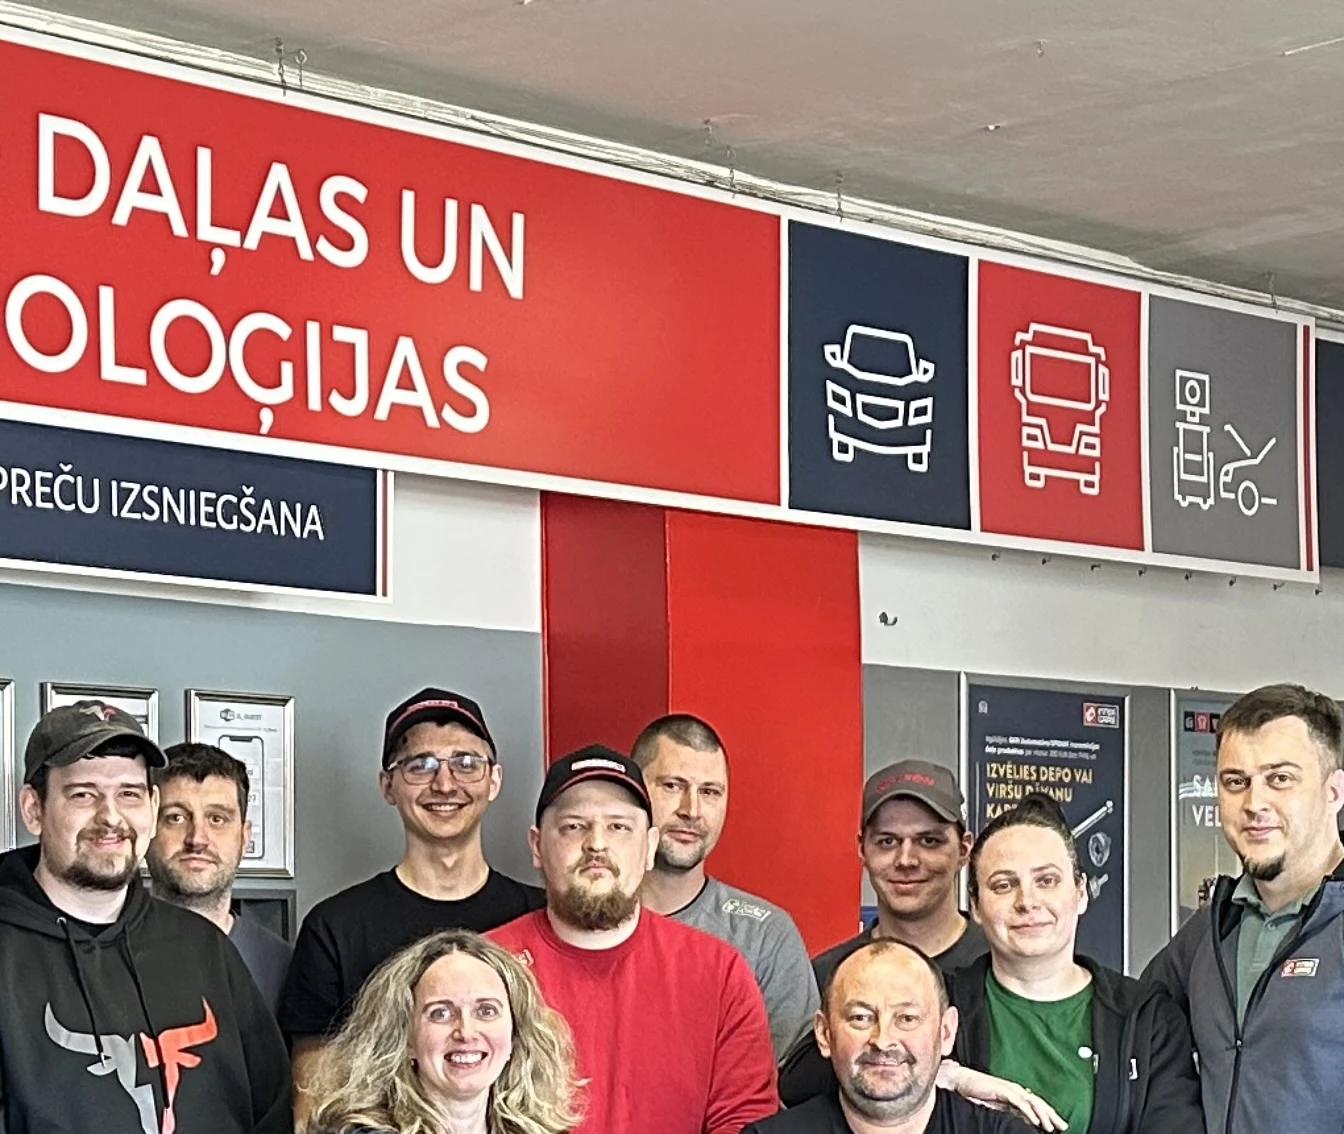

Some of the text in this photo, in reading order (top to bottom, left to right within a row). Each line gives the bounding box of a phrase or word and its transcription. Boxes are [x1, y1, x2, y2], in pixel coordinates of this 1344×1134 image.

[36, 113, 369, 277] DAĻAS
[400, 188, 527, 300] UN
[110, 480, 325, 541] IZSNIEGŠANA
[986, 781, 1022, 798] VIRŠU
